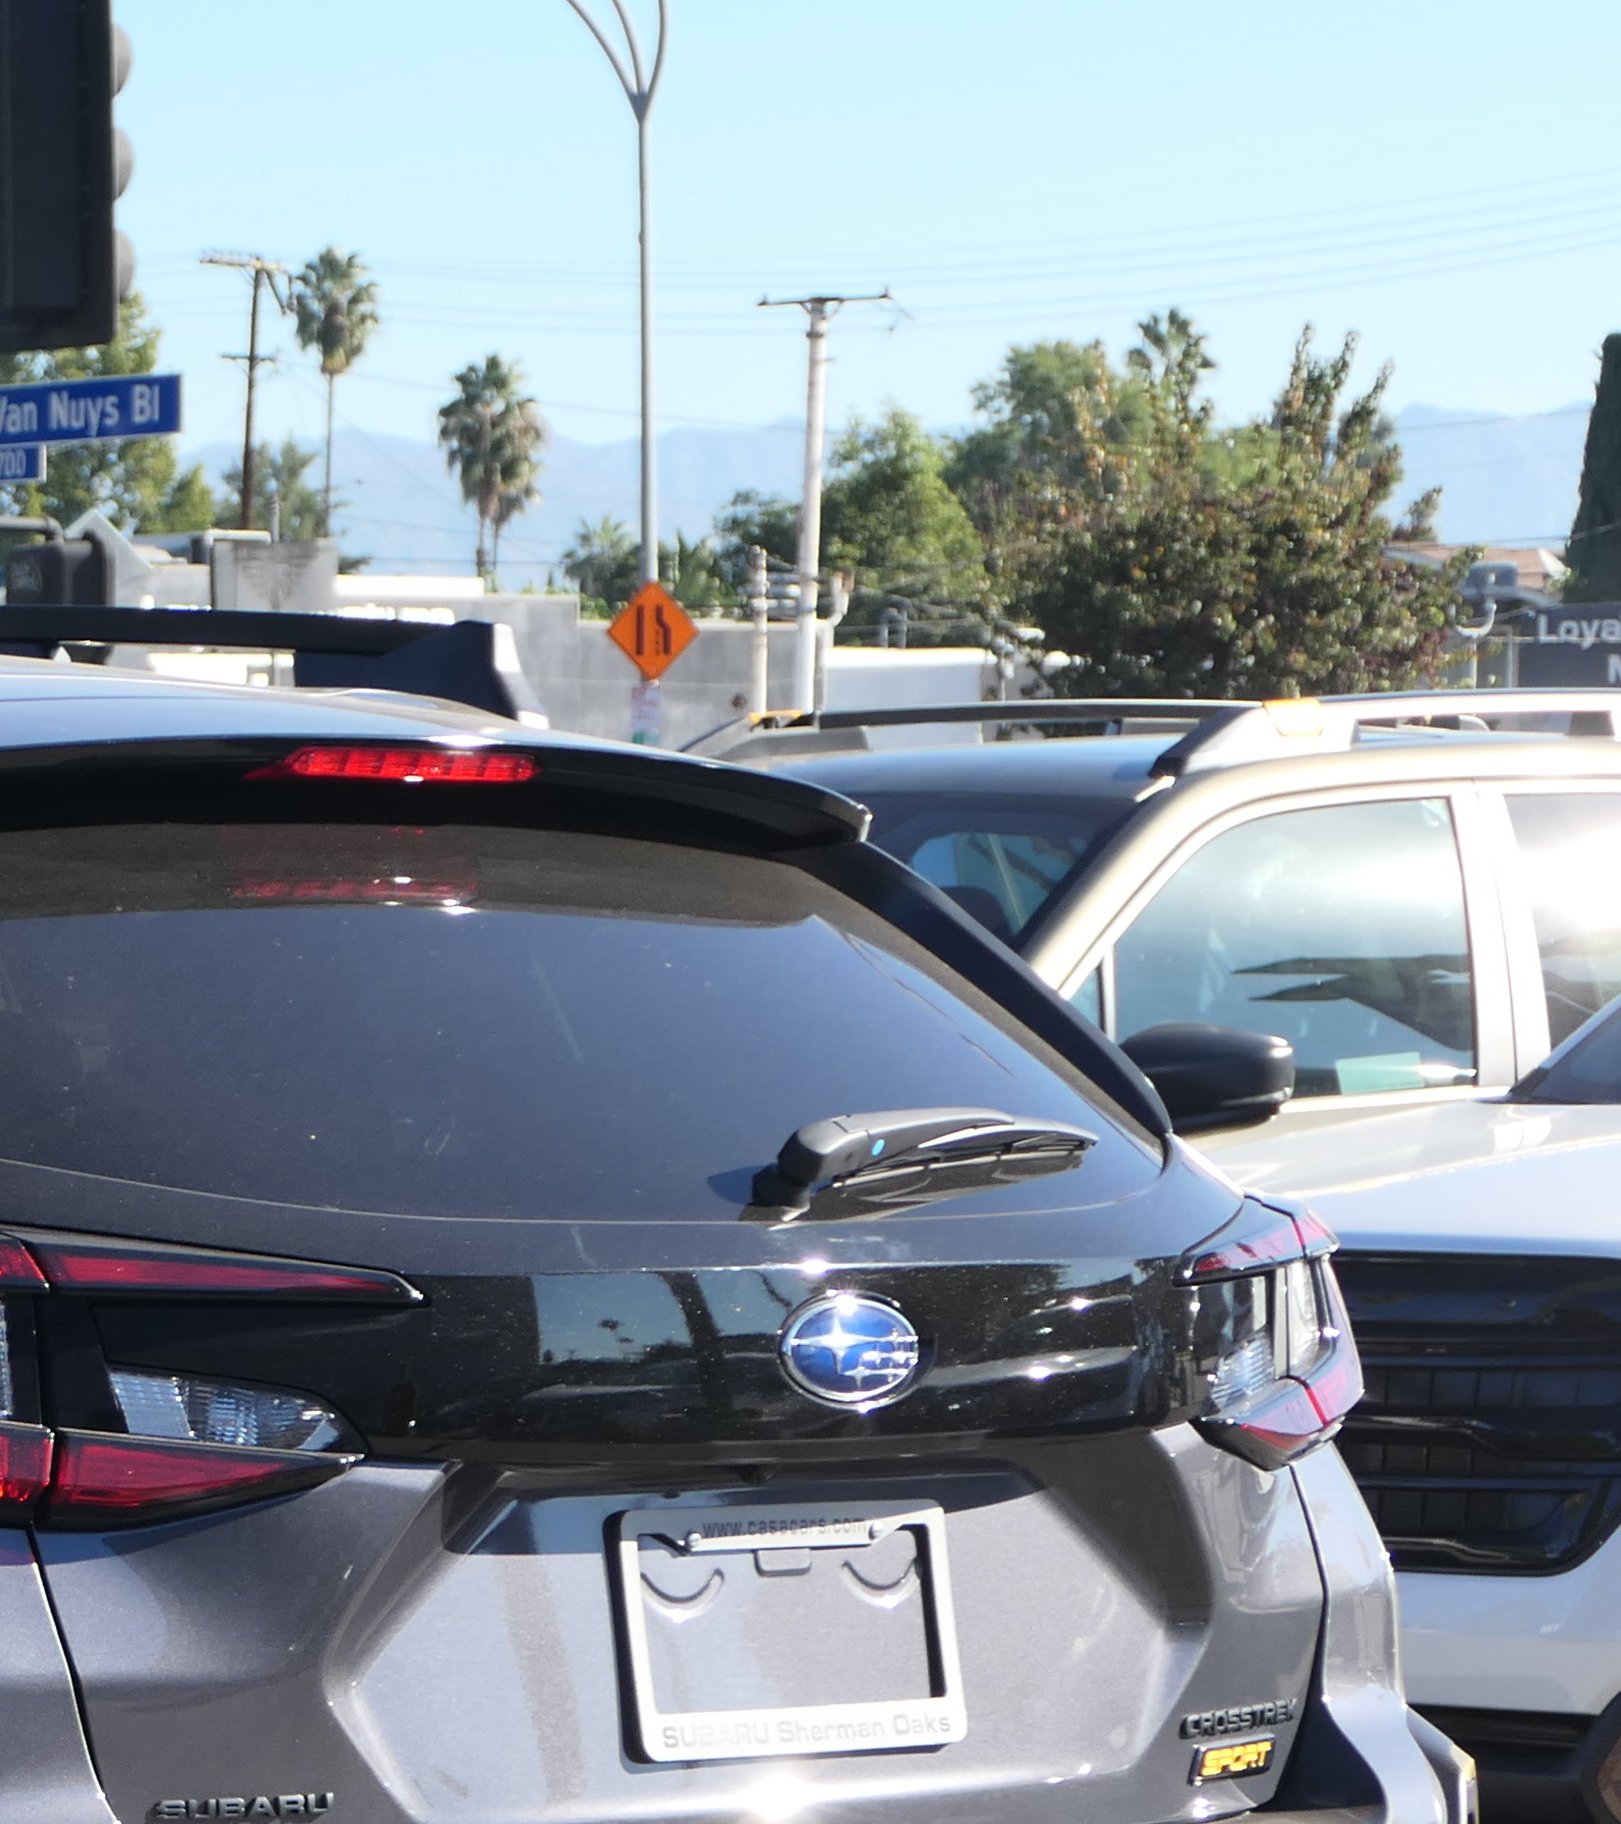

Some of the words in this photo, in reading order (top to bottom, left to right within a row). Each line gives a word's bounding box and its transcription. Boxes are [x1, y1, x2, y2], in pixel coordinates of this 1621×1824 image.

[48, 390, 120, 437] Nuys
[130, 383, 161, 424] Bl
[1538, 613, 1621, 651] Loya
[662, 1722, 770, 1748] SUBARU
[777, 1719, 885, 1743] Sherman
[893, 1713, 951, 1736] Oaks
[1184, 1698, 1297, 1737] CROSSTREK
[1200, 1740, 1273, 1776] SPORT
[156, 1792, 334, 1820] SUBARU
